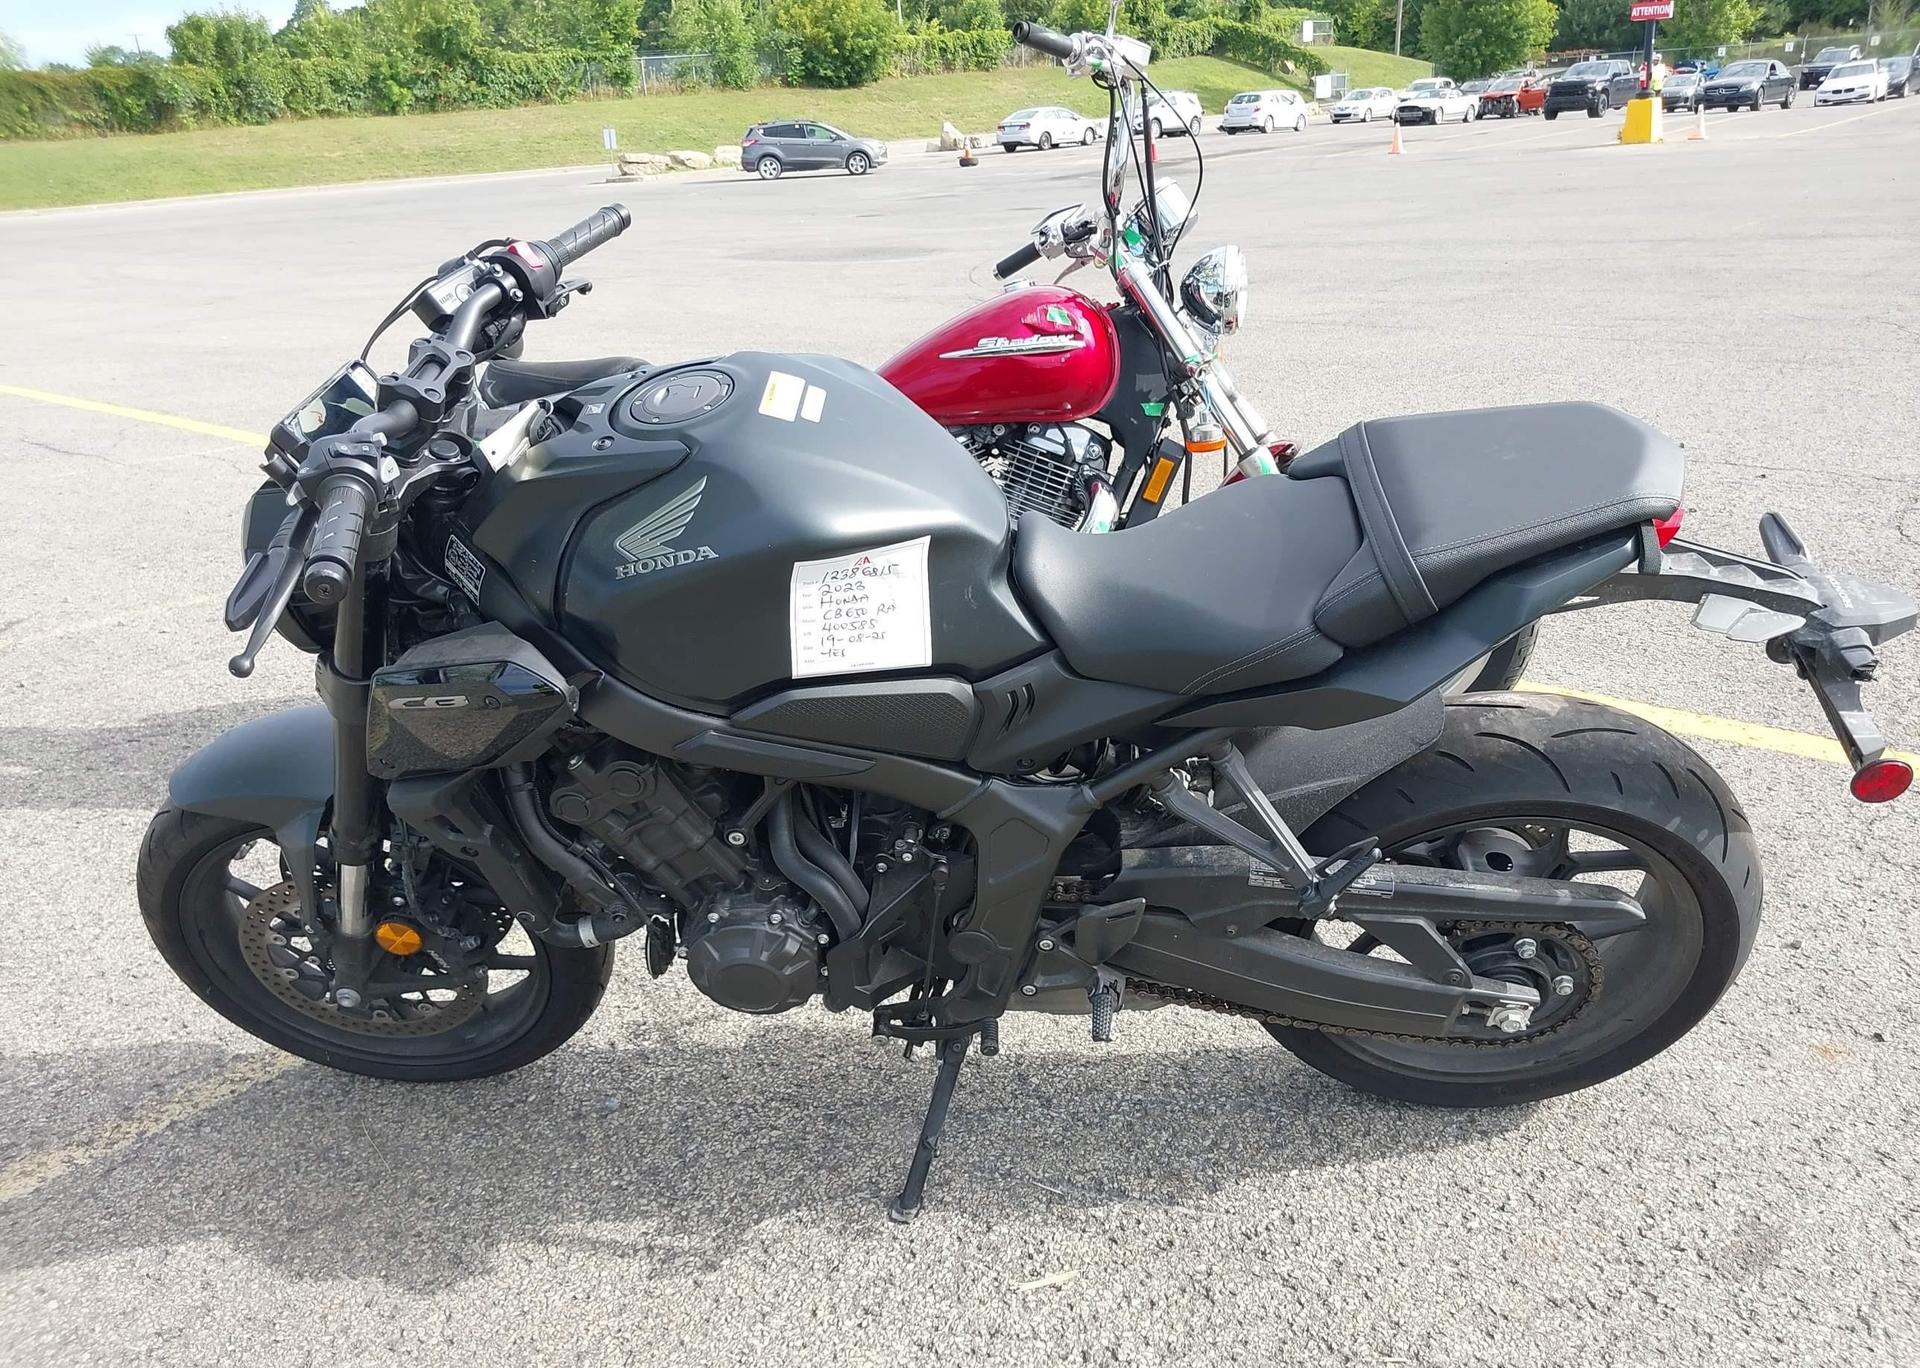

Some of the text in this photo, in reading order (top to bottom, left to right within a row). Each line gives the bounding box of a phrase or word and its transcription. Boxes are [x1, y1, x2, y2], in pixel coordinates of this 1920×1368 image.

[1631, 5, 1671, 17] ATTENTION
[977, 334, 1074, 349] Shadow
[615, 545, 719, 580] HONDA
[818, 580, 866, 596] 2023
[820, 594, 869, 608] HONDA
[388, 695, 470, 710] CB
